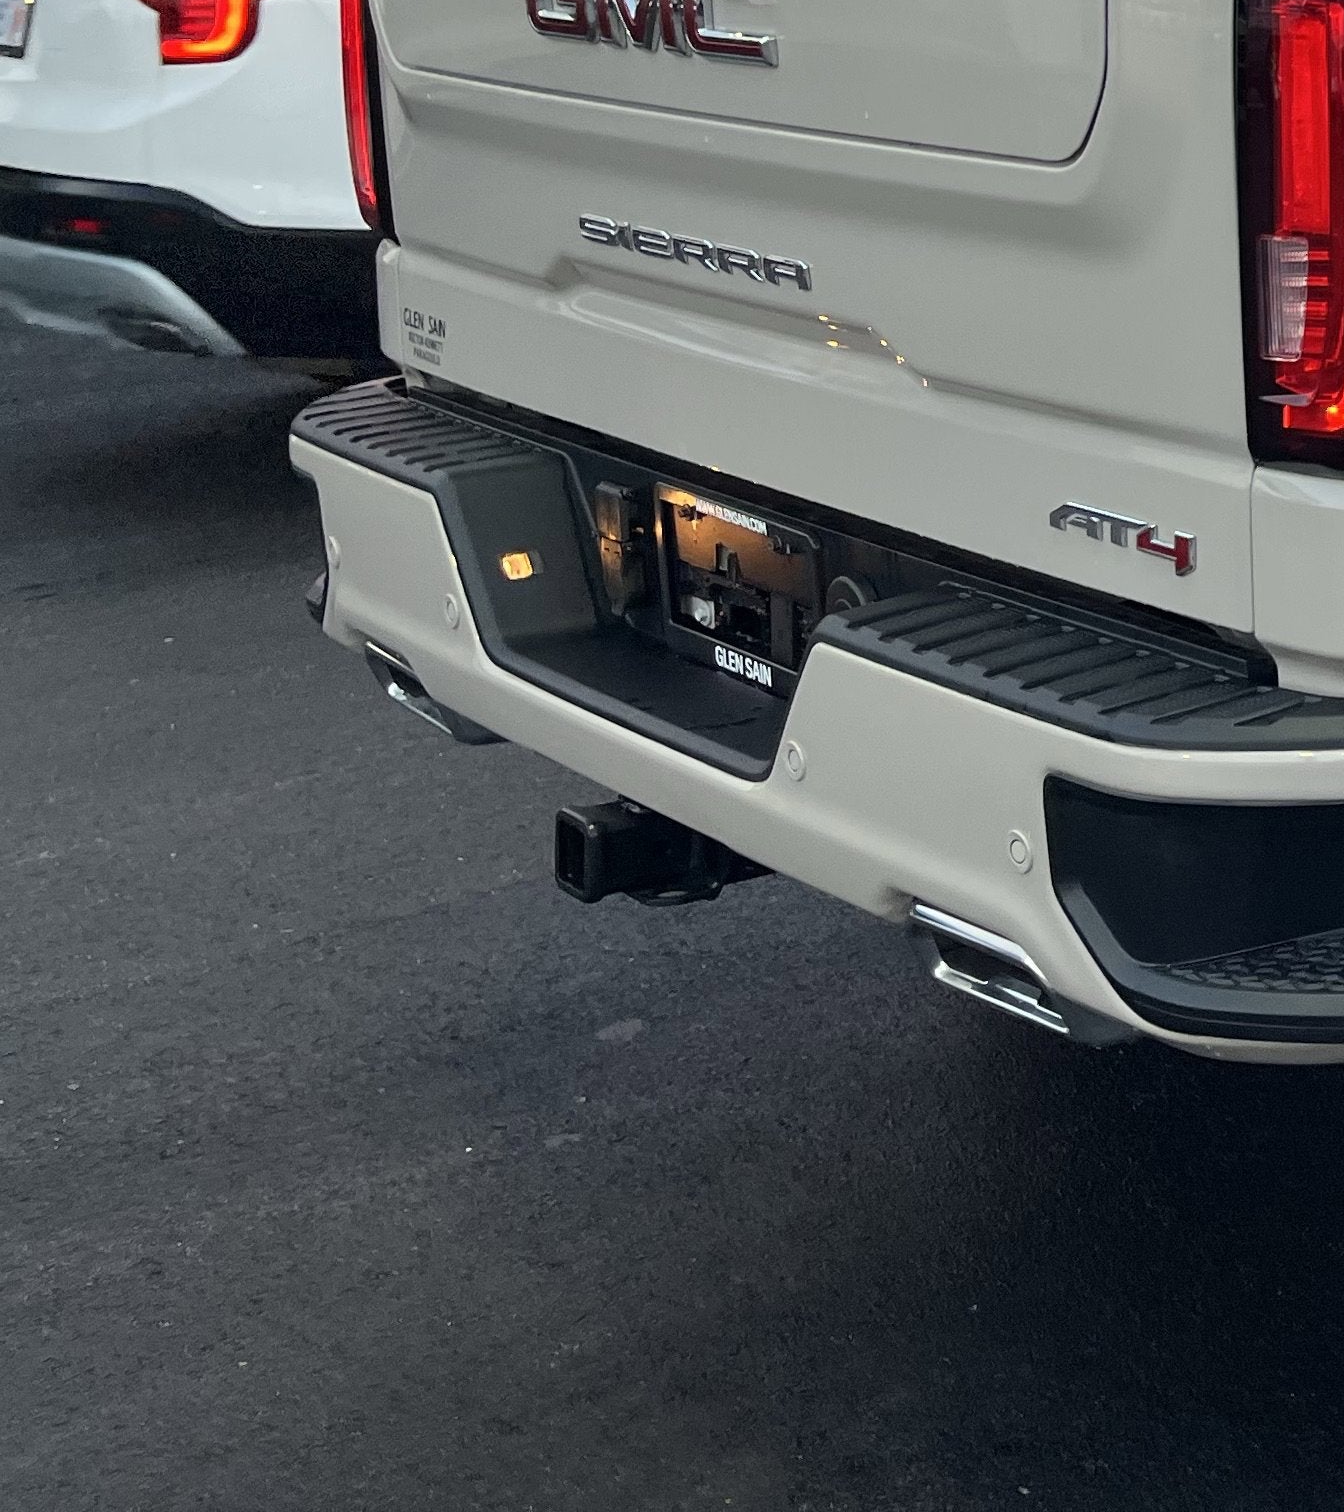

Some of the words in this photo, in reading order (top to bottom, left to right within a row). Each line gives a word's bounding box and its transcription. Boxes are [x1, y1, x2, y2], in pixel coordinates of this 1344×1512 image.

[579, 212, 812, 291] SIERRA
[403, 307, 425, 331] GLEN
[1049, 501, 1198, 577] AT4
[714, 645, 744, 676] GLEN
[744, 657, 773, 688] SAIN
